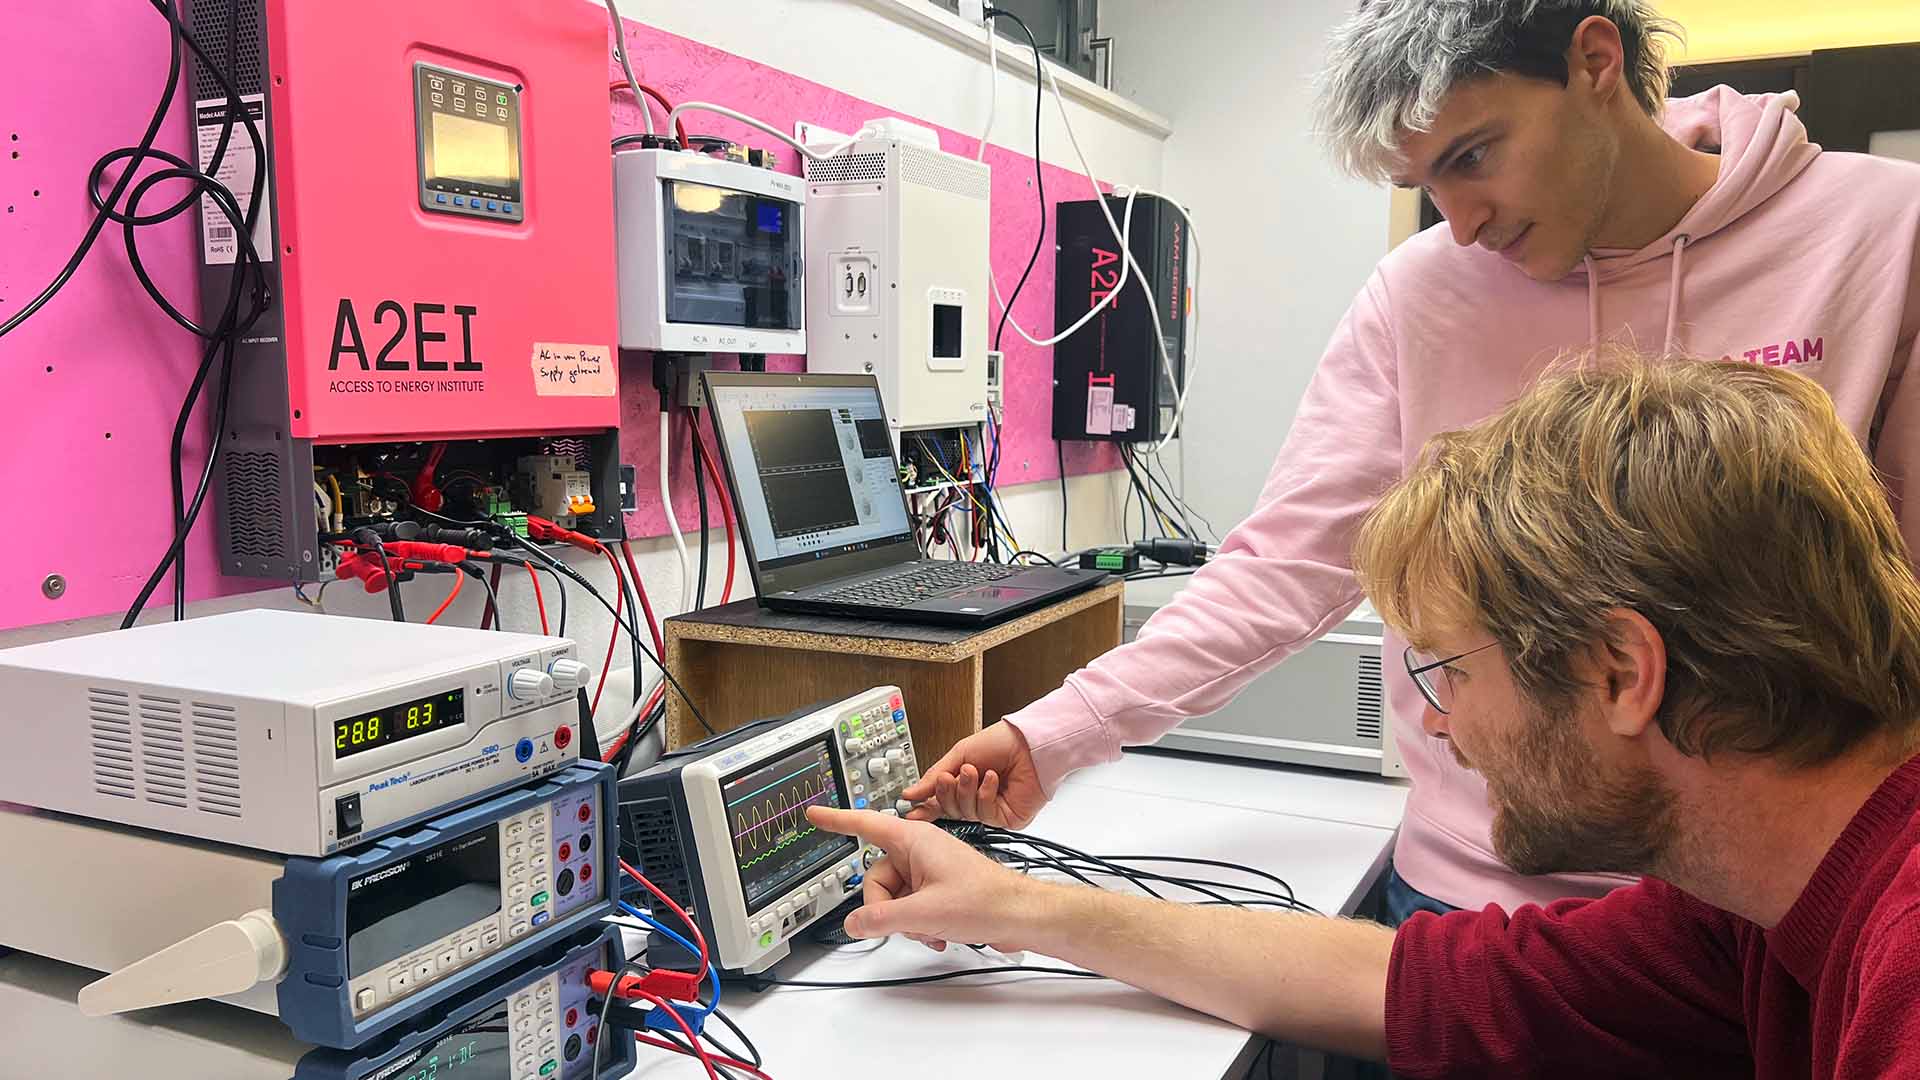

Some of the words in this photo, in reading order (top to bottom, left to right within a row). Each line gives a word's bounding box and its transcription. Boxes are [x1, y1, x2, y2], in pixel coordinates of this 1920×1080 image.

[328, 299, 483, 371] A2EI
[1744, 337, 1823, 366] TEAM
[329, 381, 374, 393] ACCESS
[378, 381, 392, 392] TO
[395, 381, 434, 393] ENERGY
[437, 381, 484, 392] INSTITUTE
[511, 658, 531, 668] VOLTAGE
[551, 648, 569, 657] CURRENT
[406, 703, 434, 730] 8.3
[336, 717, 380, 749] 28.8
